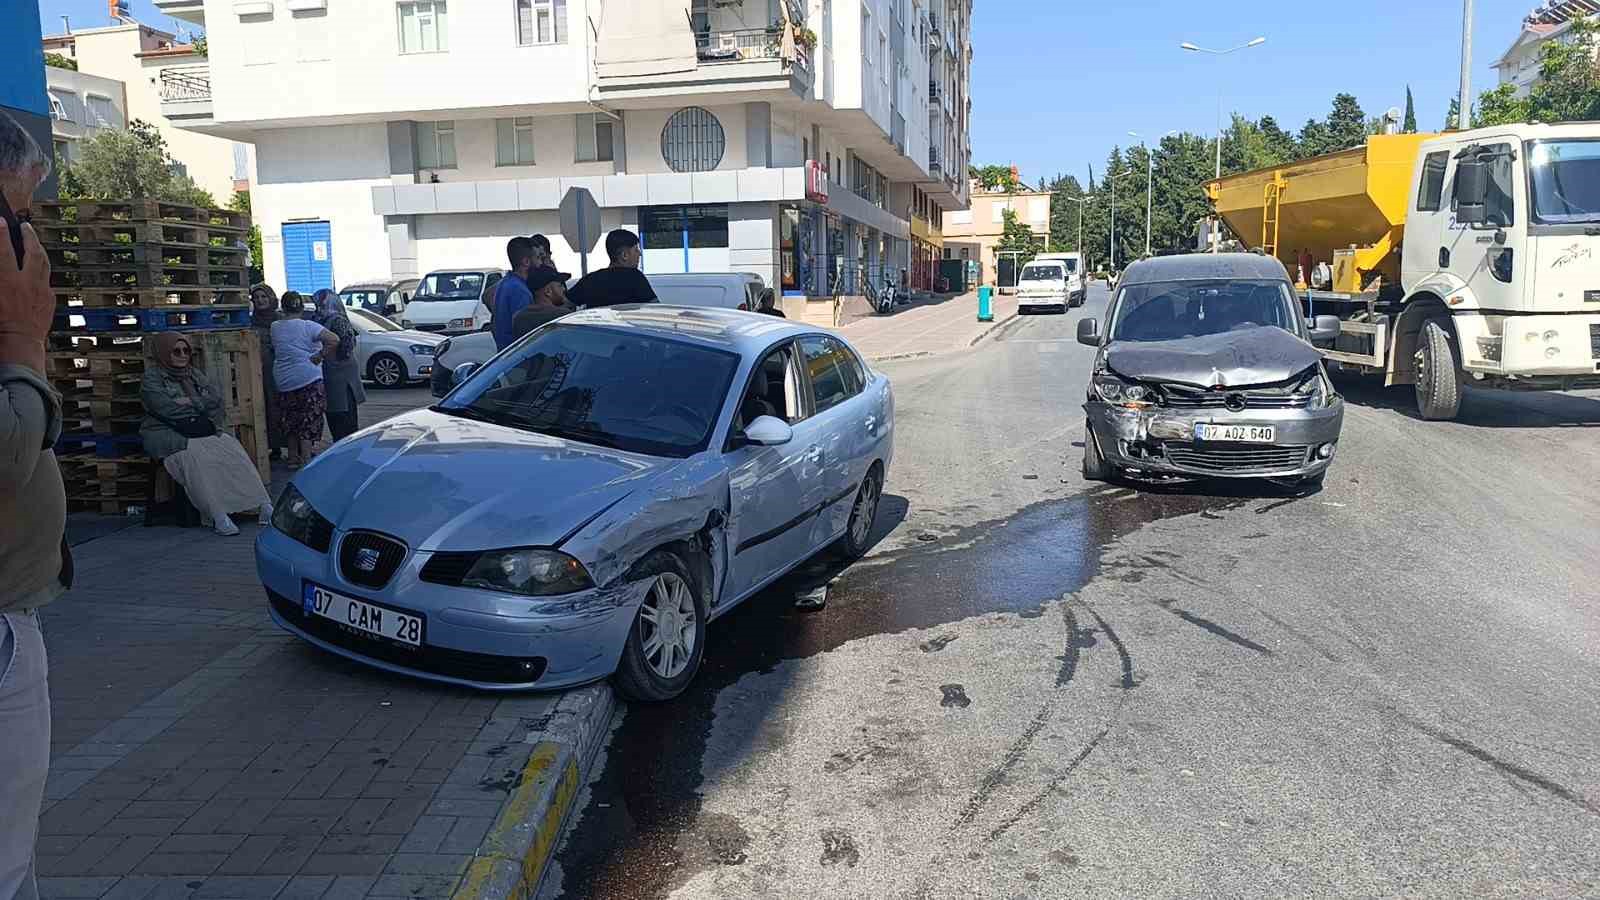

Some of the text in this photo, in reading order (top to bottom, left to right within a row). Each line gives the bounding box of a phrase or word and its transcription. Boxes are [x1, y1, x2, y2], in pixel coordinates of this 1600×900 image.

[1250, 428, 1272, 440] 640
[314, 589, 333, 615] 07
[348, 601, 383, 633] CAM
[396, 616, 420, 642] 28
